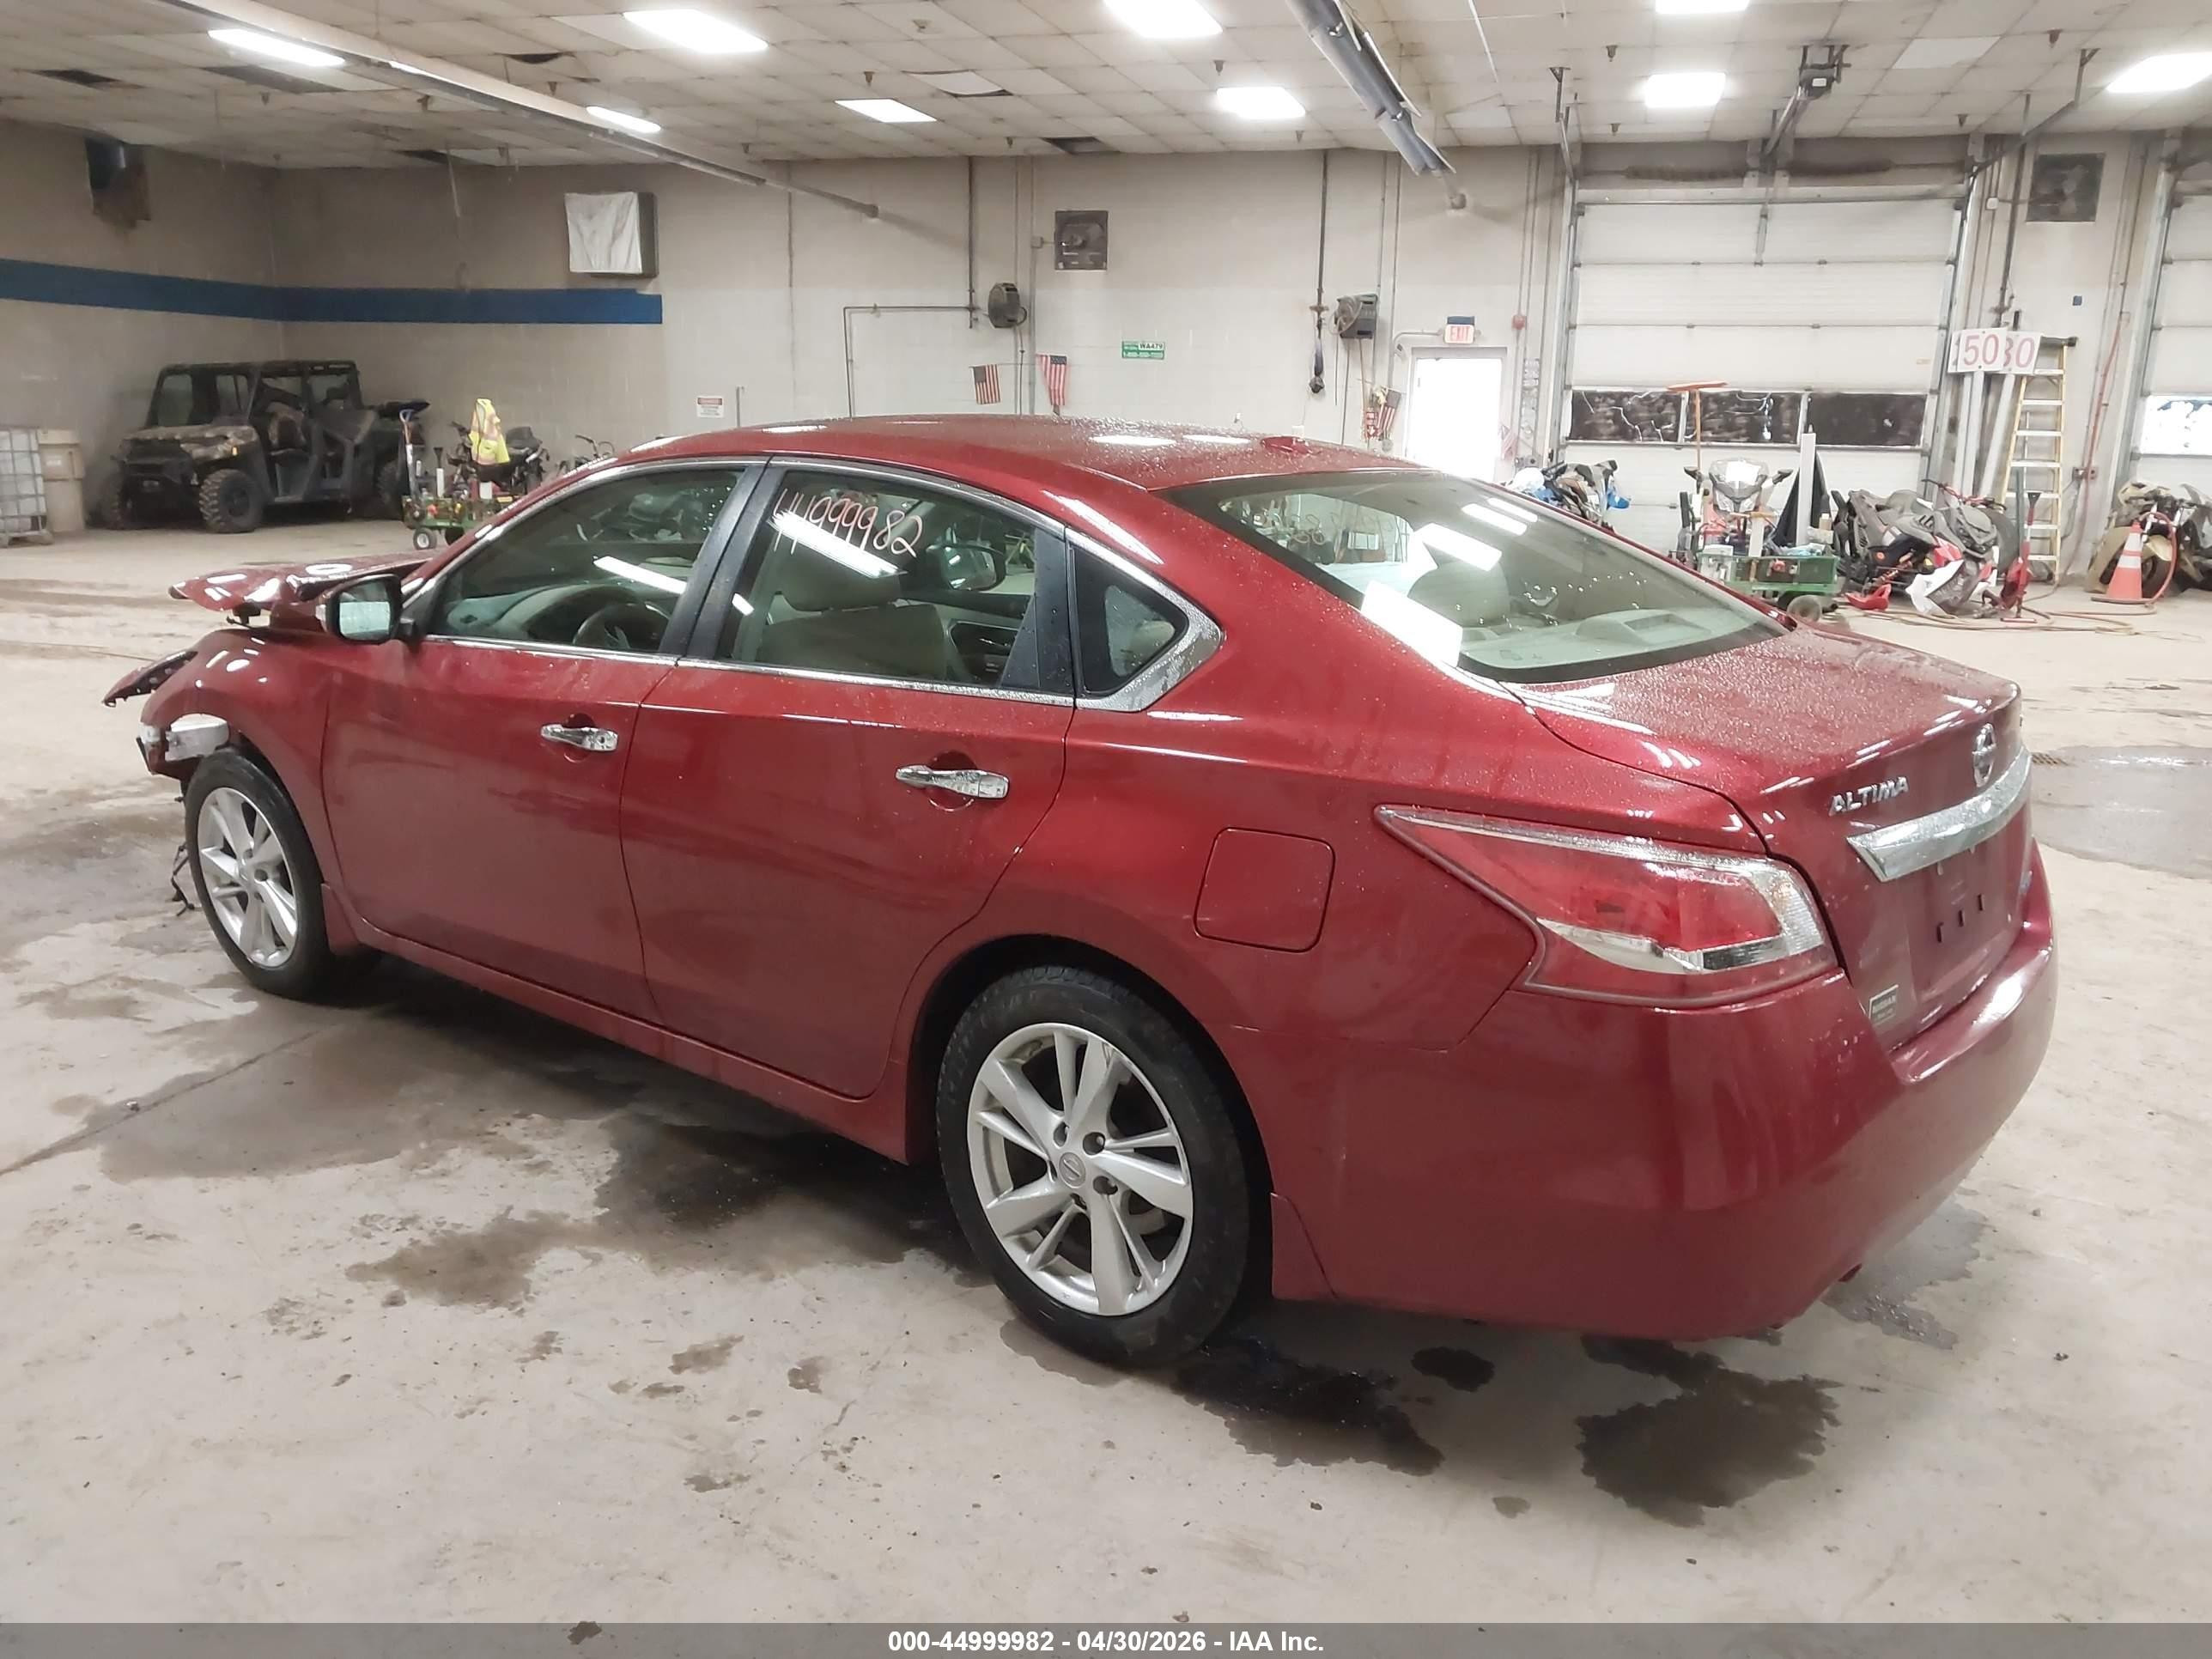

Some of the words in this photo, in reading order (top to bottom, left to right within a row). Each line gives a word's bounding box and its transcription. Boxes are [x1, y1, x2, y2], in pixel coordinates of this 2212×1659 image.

[1449, 325, 1471, 342] EXIT
[1964, 334, 2000, 366] 50
[772, 488, 923, 558] 44999982
[1828, 776, 1909, 816] ALTIMA
